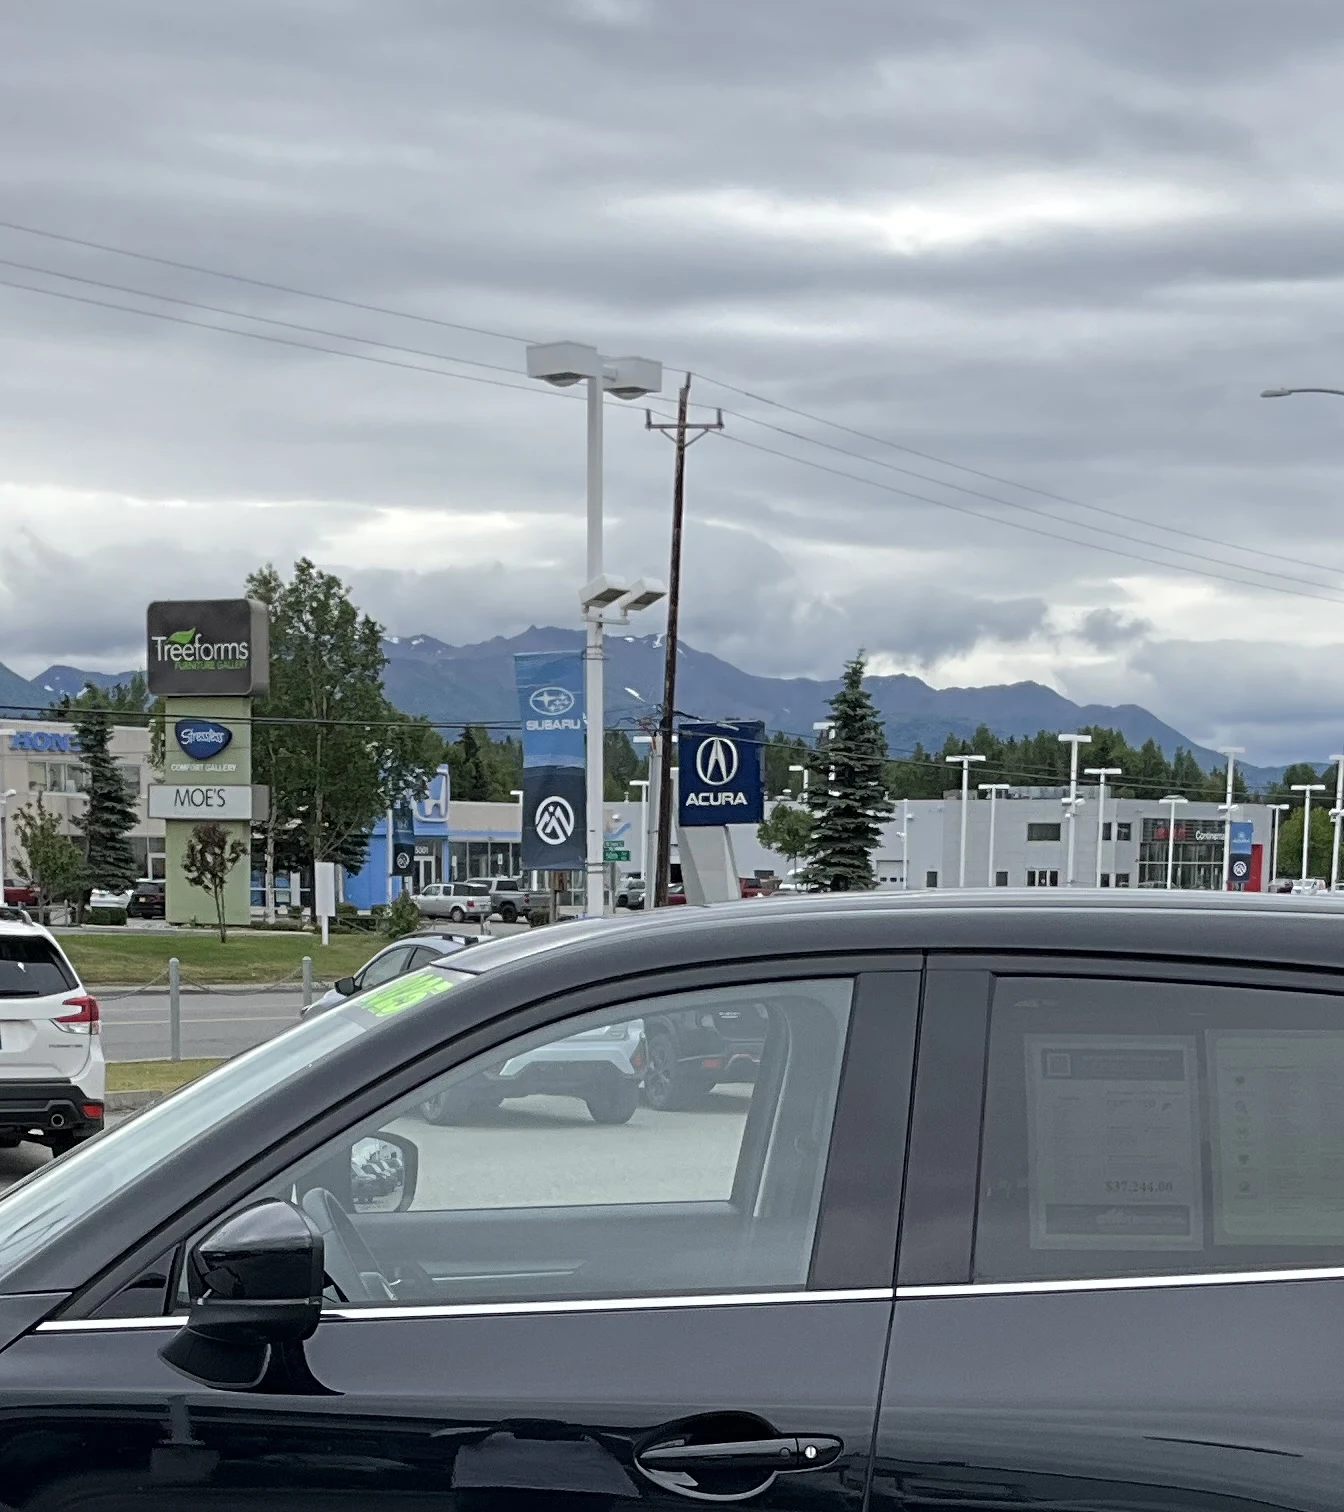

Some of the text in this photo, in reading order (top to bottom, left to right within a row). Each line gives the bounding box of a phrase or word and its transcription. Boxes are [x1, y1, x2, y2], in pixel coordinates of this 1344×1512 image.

[151, 633, 249, 661] Treeforms
[525, 719, 581, 731] SUBARU
[180, 728, 224, 745] Stressless
[171, 763, 237, 772] COMFORT GALLERY
[174, 788, 226, 807] MOE'S
[685, 791, 748, 806] ACURA
[415, 846, 429, 854] 5001
